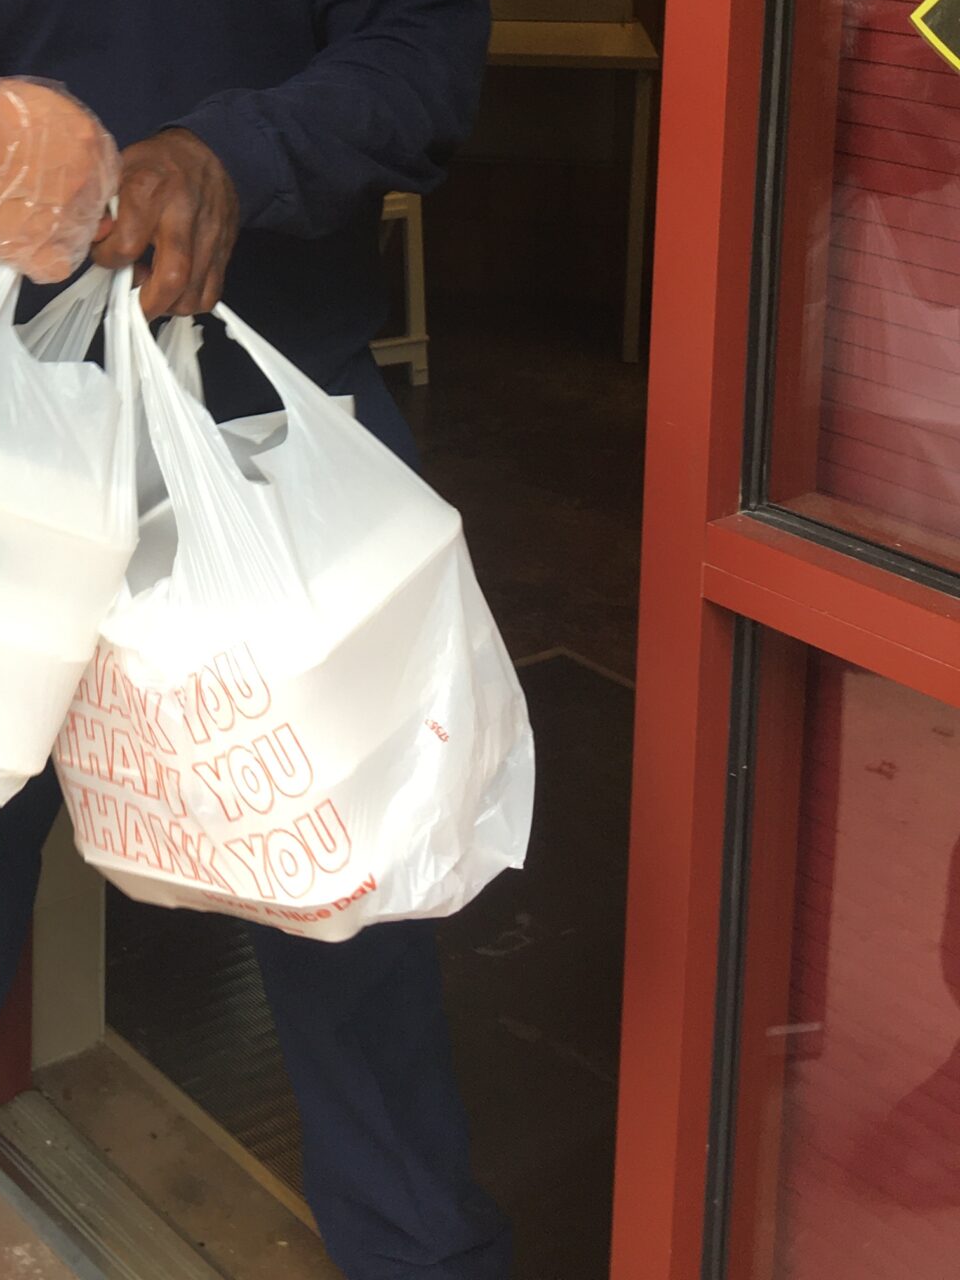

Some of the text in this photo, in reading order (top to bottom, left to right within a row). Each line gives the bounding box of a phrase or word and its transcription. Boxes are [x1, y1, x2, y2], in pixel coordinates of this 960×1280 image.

[172, 641, 272, 745] YOU
[192, 722, 314, 822] YOU
[62, 775, 352, 900] THANK YOU
[282, 907, 333, 923] Nice
[331, 872, 378, 912] Day
